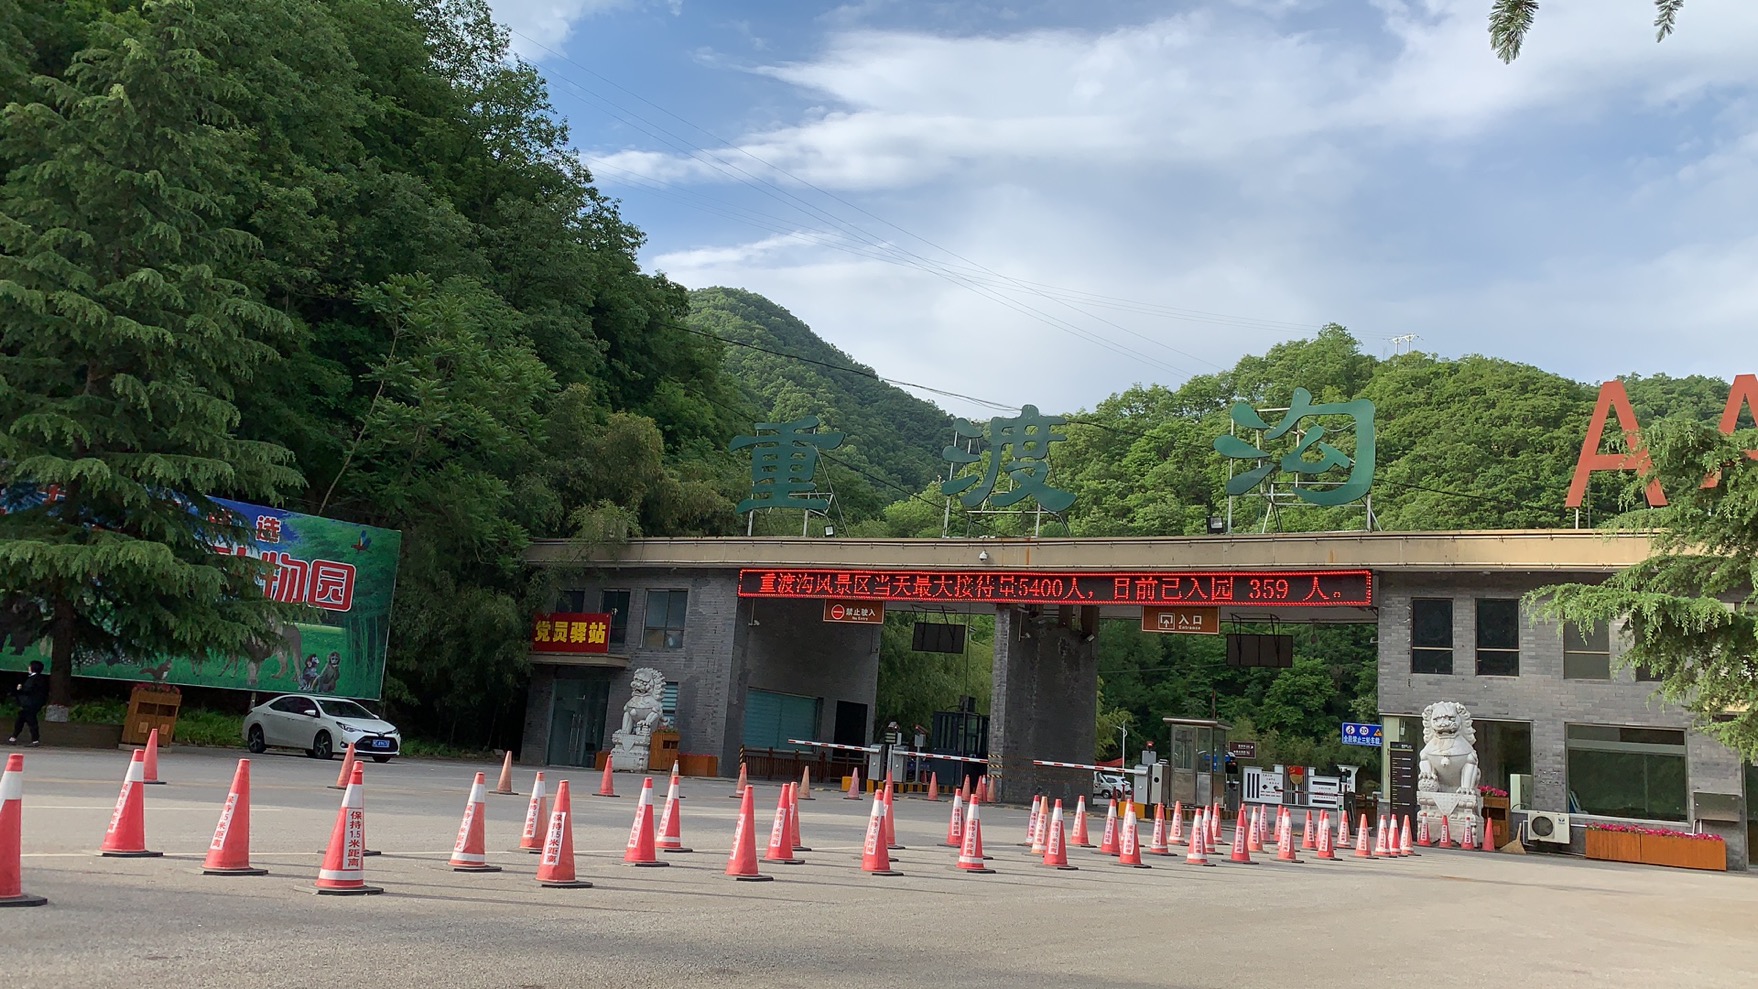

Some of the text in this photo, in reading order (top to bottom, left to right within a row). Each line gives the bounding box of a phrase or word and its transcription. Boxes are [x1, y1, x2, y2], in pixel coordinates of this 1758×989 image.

[730, 386, 1376, 514] 重渡沟
[1248, 579, 1289, 599] 359
[846, 607, 876, 617] 禁止驶入
[1178, 614, 1202, 625] 入口
[535, 620, 606, 644] 党员驿站
[347, 811, 362, 868] 保持1.5米距离
[546, 814, 563, 863] 保持1.5米距离
